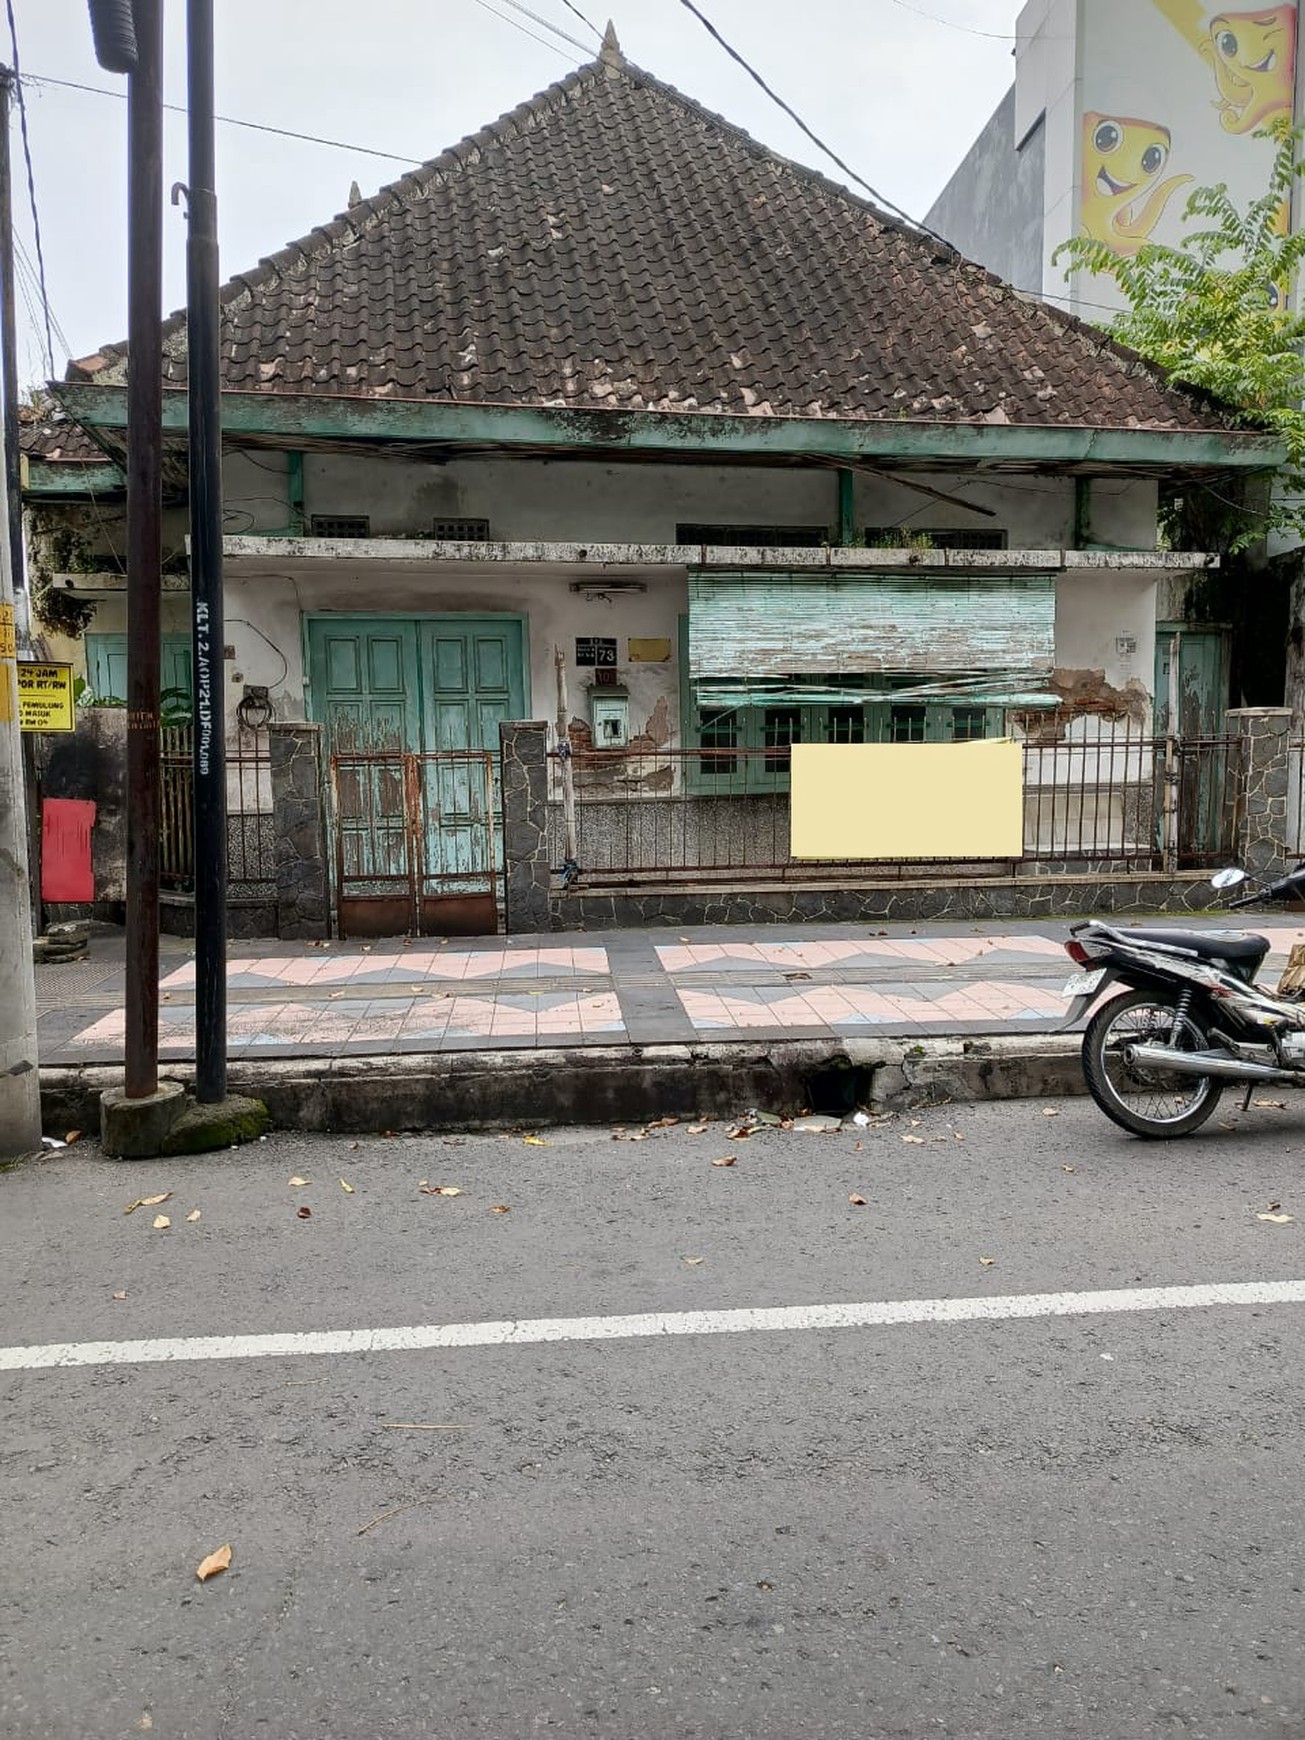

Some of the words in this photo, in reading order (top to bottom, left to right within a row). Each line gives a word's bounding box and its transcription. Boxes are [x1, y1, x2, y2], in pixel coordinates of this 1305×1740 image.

[599, 649, 615, 661] 73
[21, 668, 34, 677] 24
[36, 669, 58, 678] JAM
